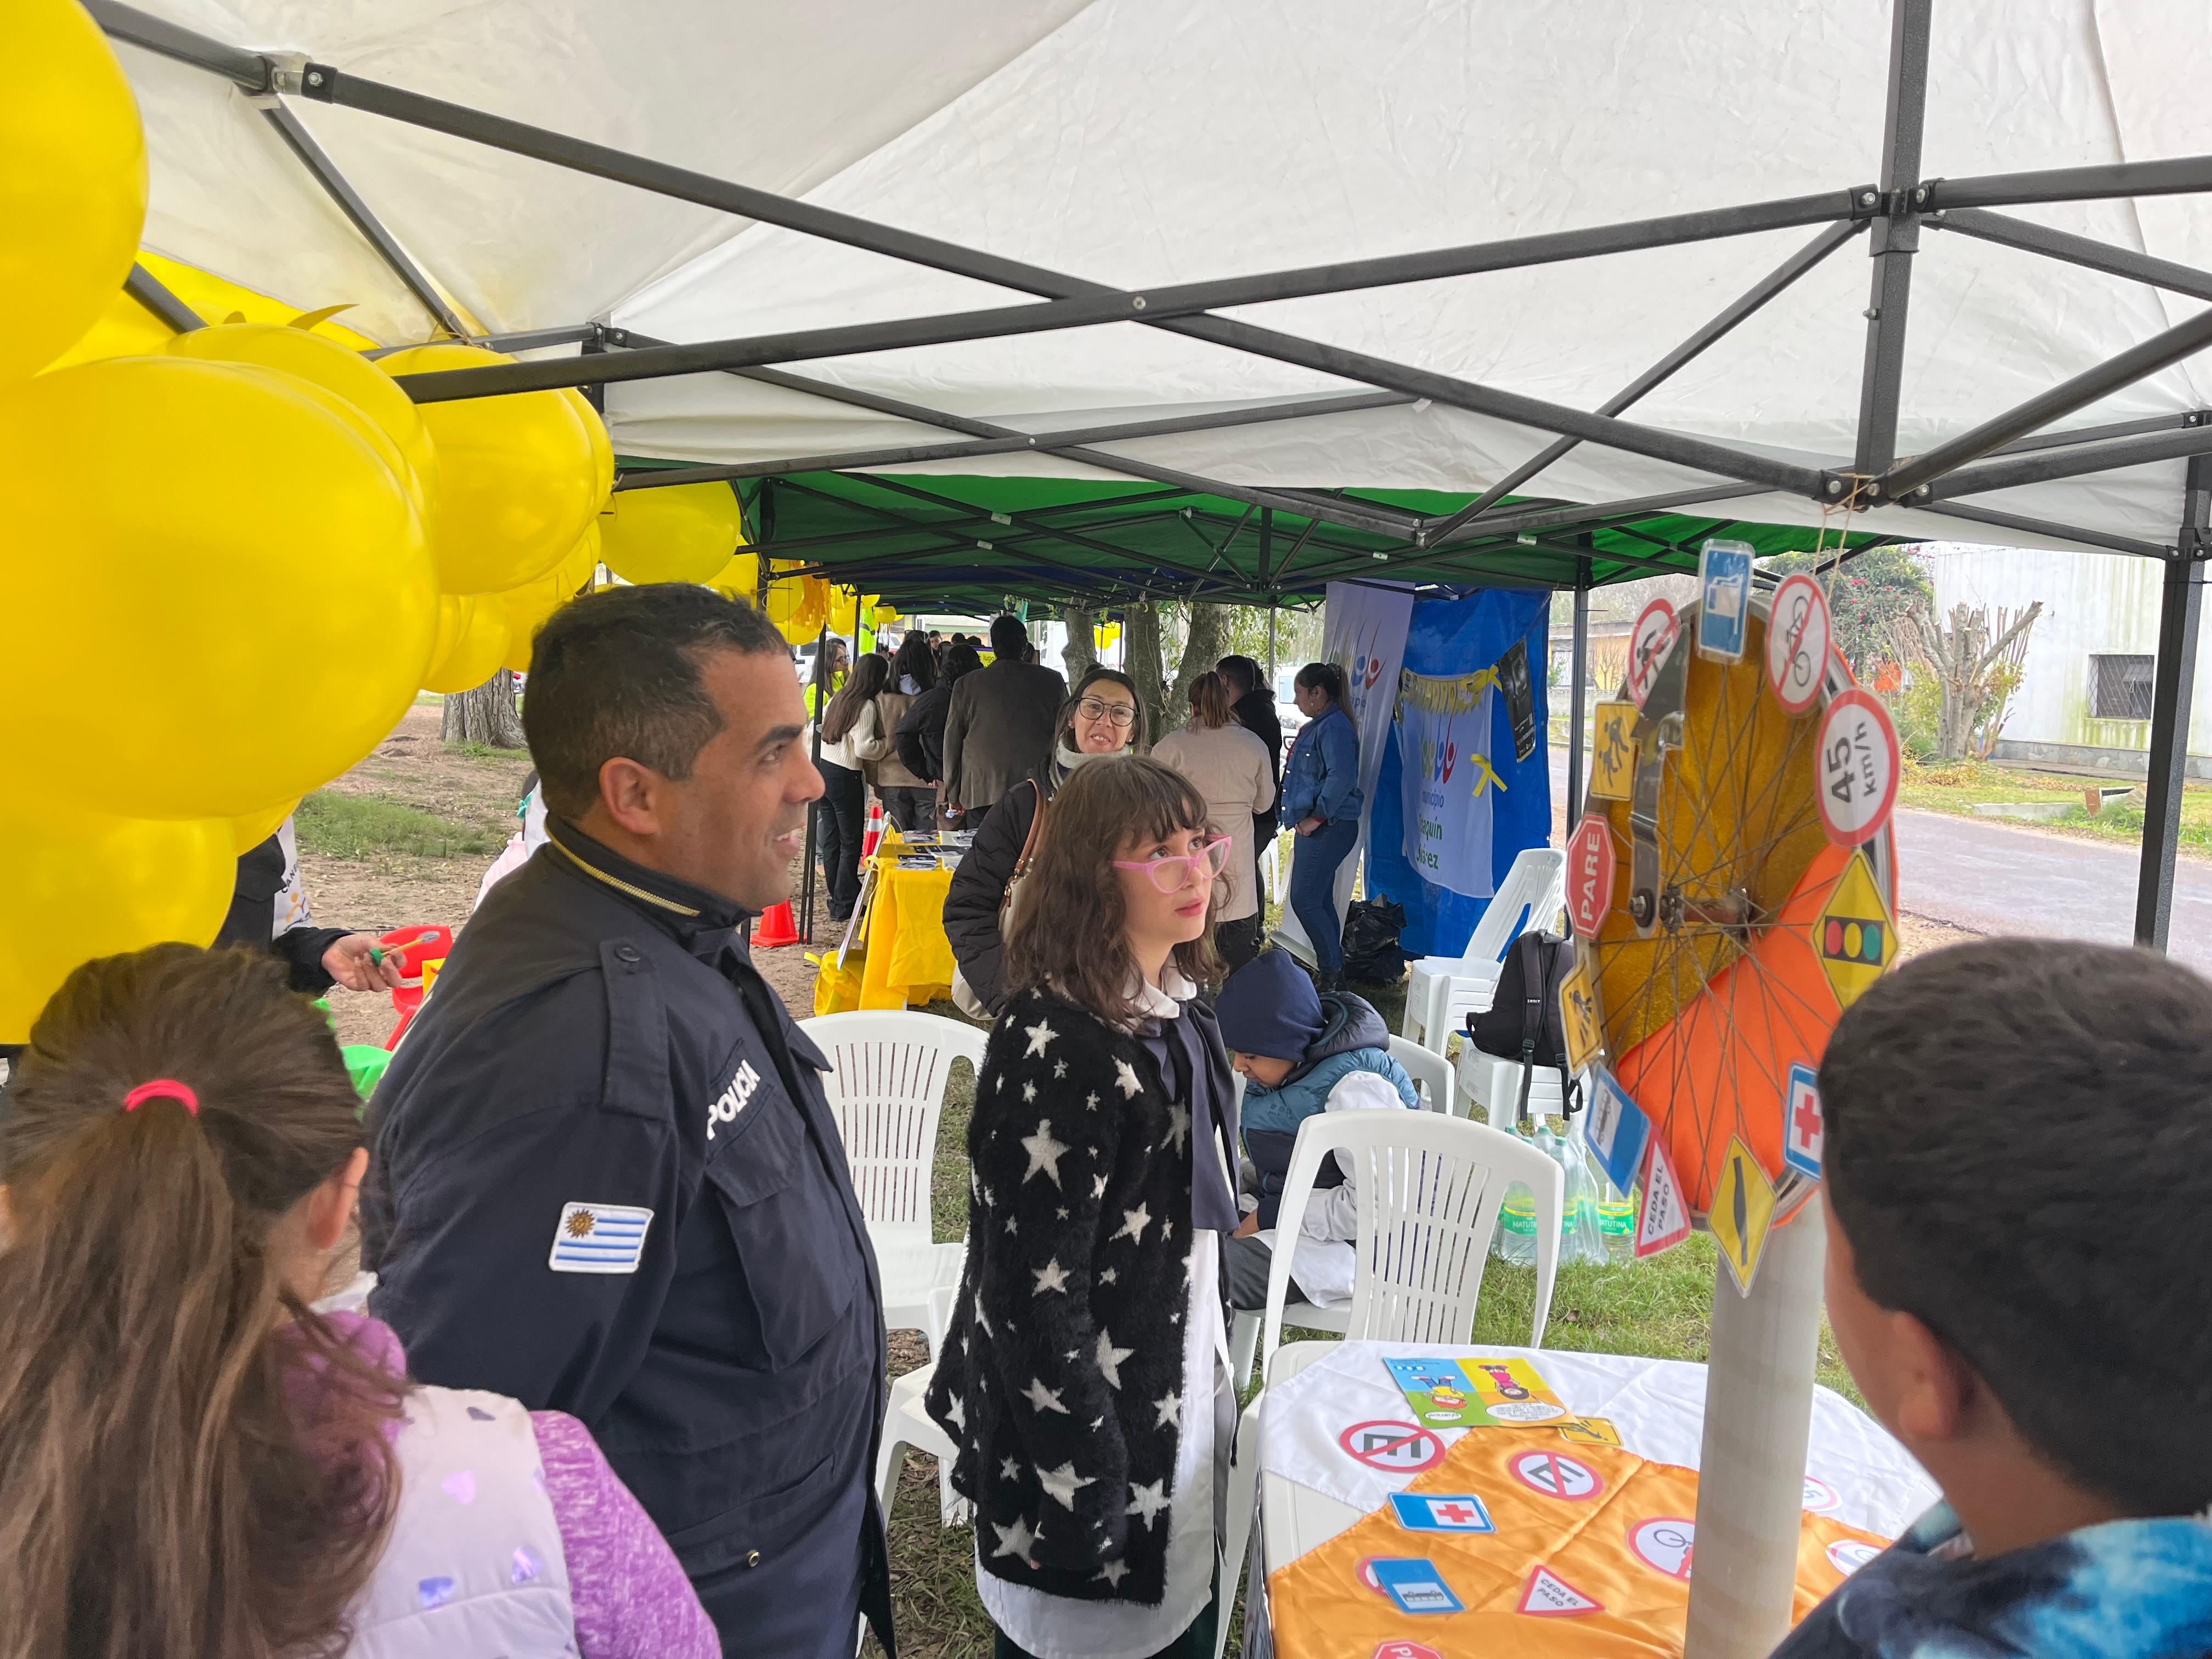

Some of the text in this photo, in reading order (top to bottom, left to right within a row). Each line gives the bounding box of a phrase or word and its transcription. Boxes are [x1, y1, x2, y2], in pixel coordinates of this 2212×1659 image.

[1826, 737, 1855, 803] 45
[1854, 722, 1877, 797] km/h
[1581, 832, 1600, 921] PARE
[1648, 1165, 1663, 1235] CEDA EL
[1658, 1183, 1669, 1230] PASO
[1537, 1588, 1564, 1606] PASO
[1541, 1579, 1579, 1606] CEDA EL
